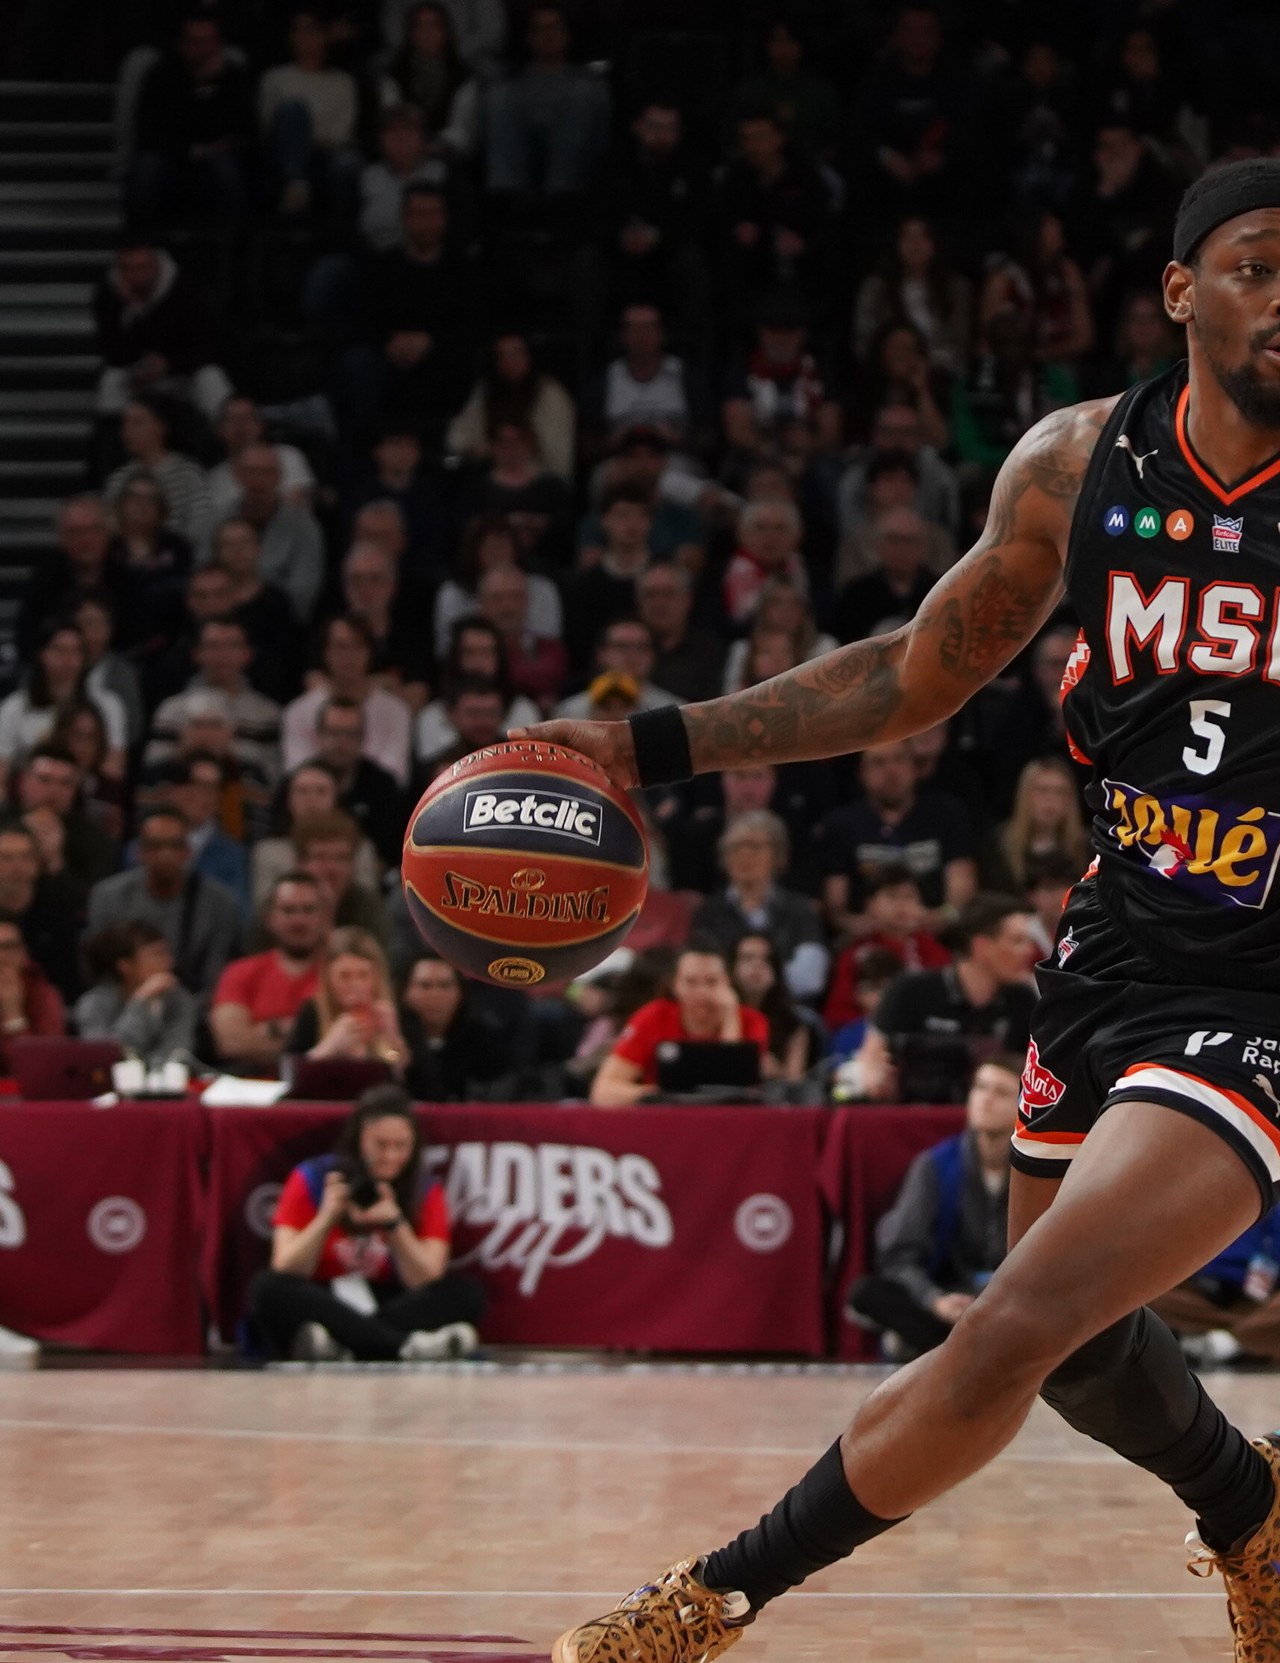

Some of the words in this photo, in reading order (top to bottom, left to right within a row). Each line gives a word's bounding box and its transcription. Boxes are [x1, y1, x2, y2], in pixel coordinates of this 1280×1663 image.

[1182, 699, 1231, 776] 5
[469, 794, 597, 836] Betclic
[441, 870, 610, 924] SPALDING
[421, 1141, 675, 1249] ADERS
